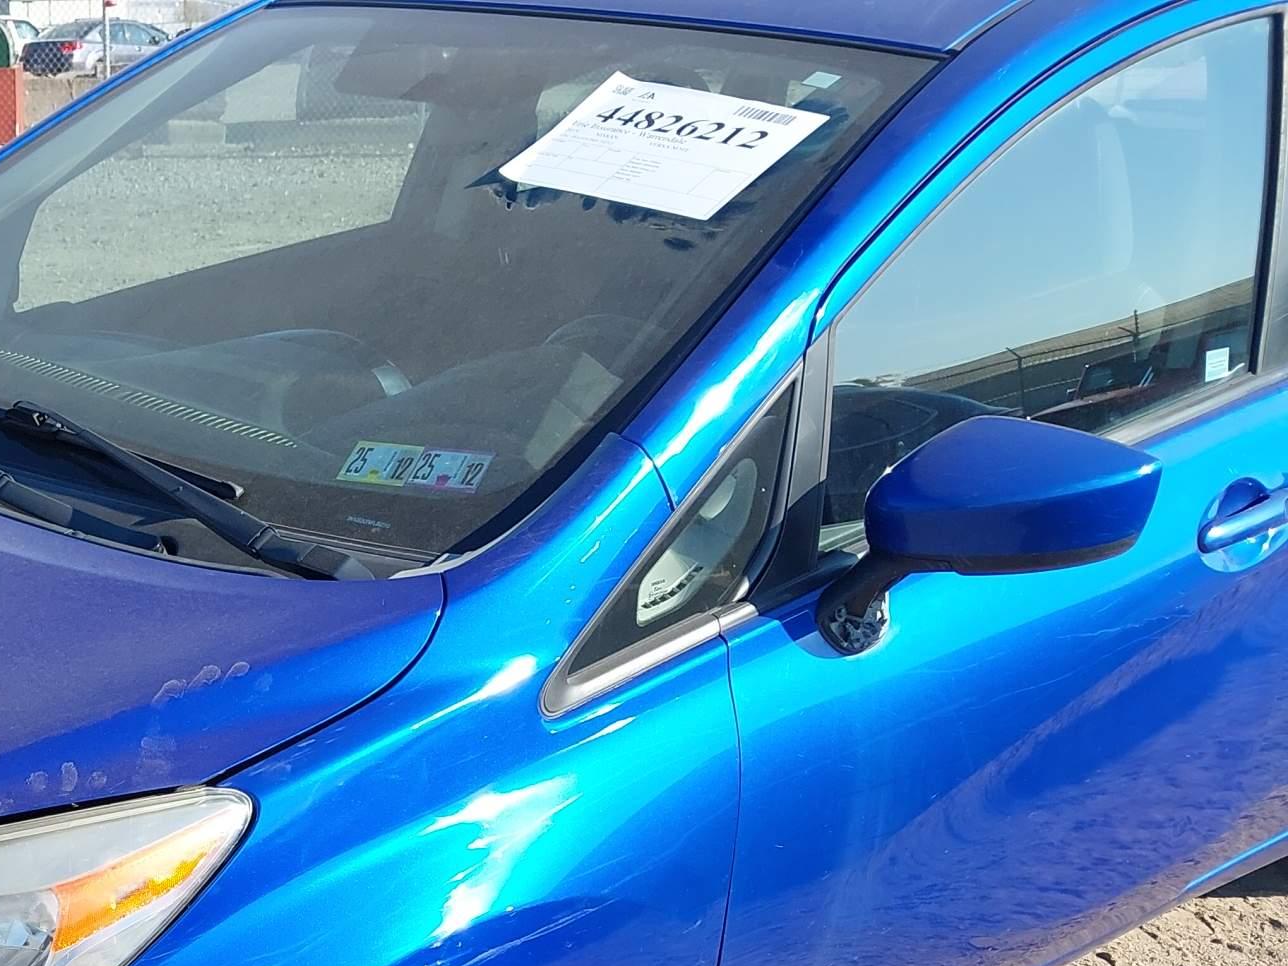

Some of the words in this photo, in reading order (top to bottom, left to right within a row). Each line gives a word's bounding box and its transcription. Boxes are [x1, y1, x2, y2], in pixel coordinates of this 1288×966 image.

[595, 104, 769, 150] 44826212
[345, 447, 375, 474] 25
[390, 456, 414, 481] 12
[412, 453, 441, 481] 25
[461, 462, 485, 487] 12
